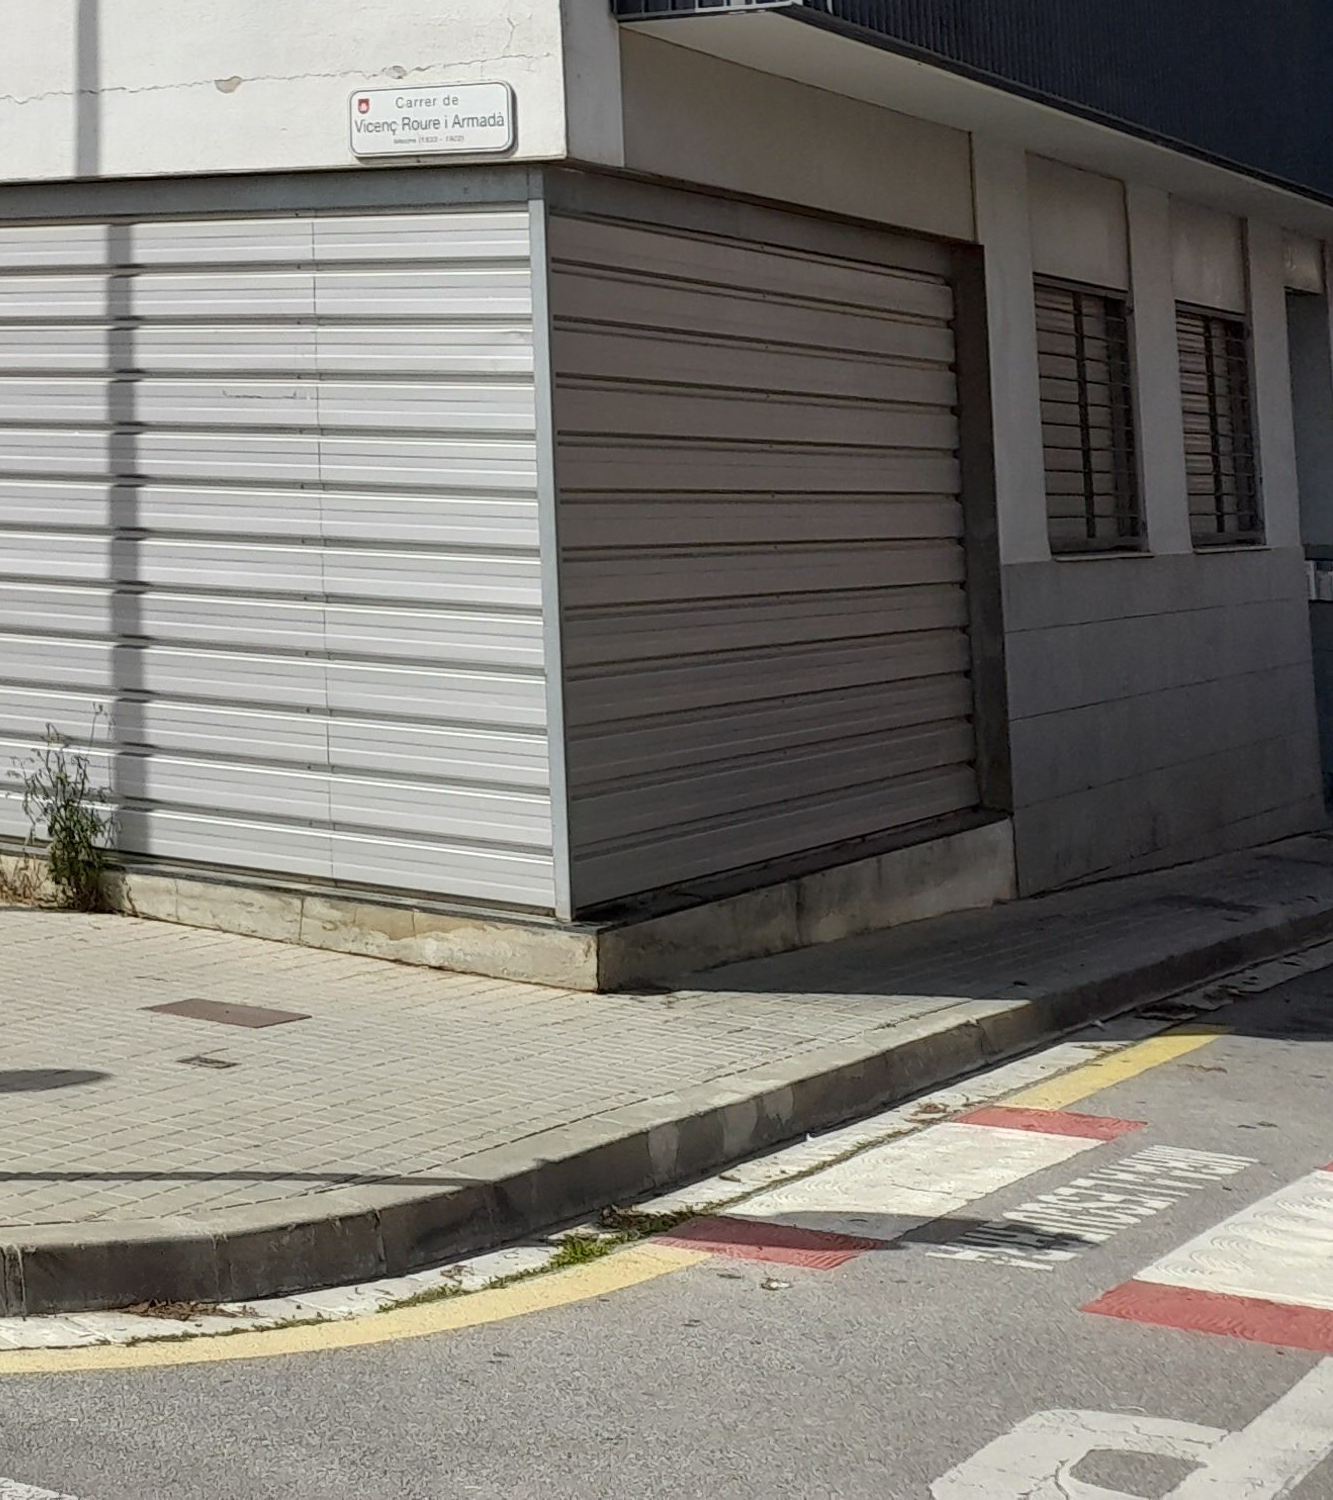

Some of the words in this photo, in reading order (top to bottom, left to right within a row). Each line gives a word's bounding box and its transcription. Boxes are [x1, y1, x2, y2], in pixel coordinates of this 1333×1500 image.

[395, 96, 436, 108] Carrer
[442, 95, 459, 106] de
[355, 119, 397, 135] Vicenç
[402, 116, 440, 131] Roure
